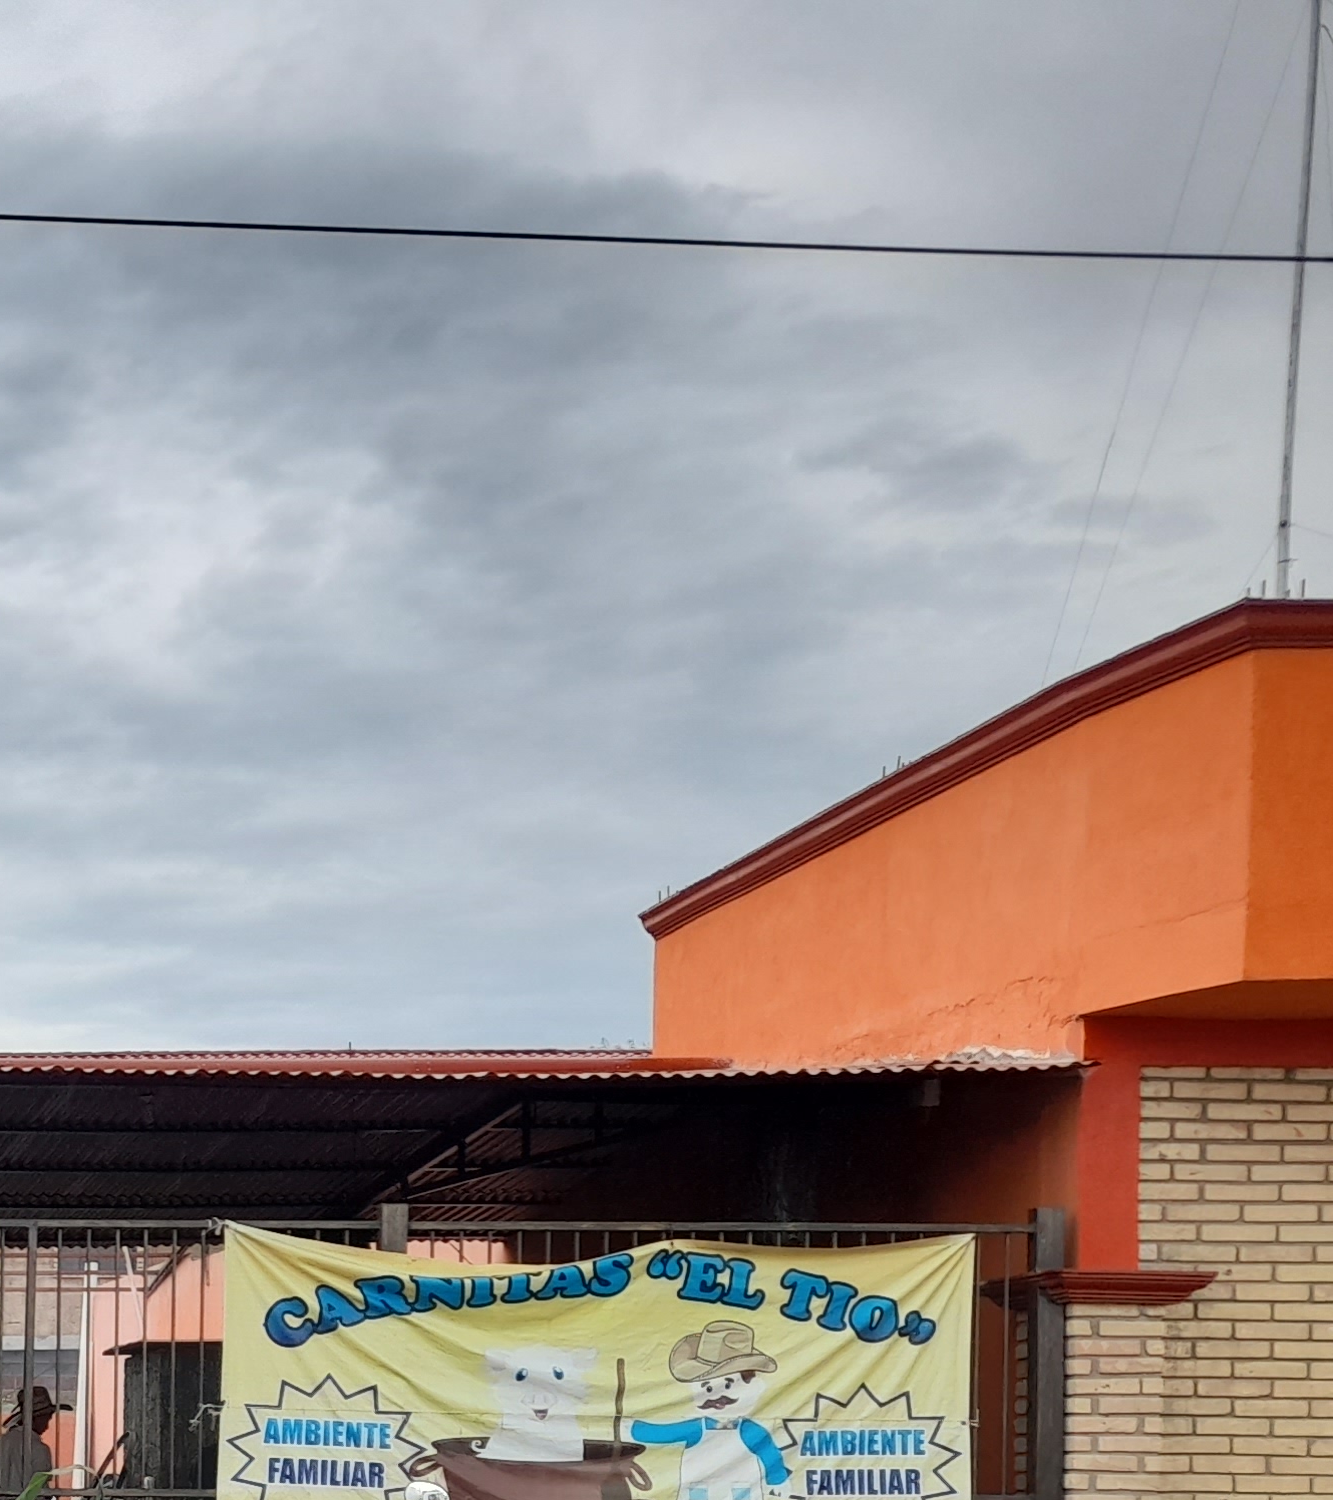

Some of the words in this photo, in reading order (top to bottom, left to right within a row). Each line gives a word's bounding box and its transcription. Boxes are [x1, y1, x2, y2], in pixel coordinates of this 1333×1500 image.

[646, 1249, 766, 1311] “EL
[779, 1268, 936, 1346] TIO”
[263, 1417, 392, 1450] AMBIENTE
[800, 1429, 926, 1457] AMBIENTE
[268, 1457, 386, 1489] FAMILIAR
[805, 1468, 921, 1496] FAMILIAR
